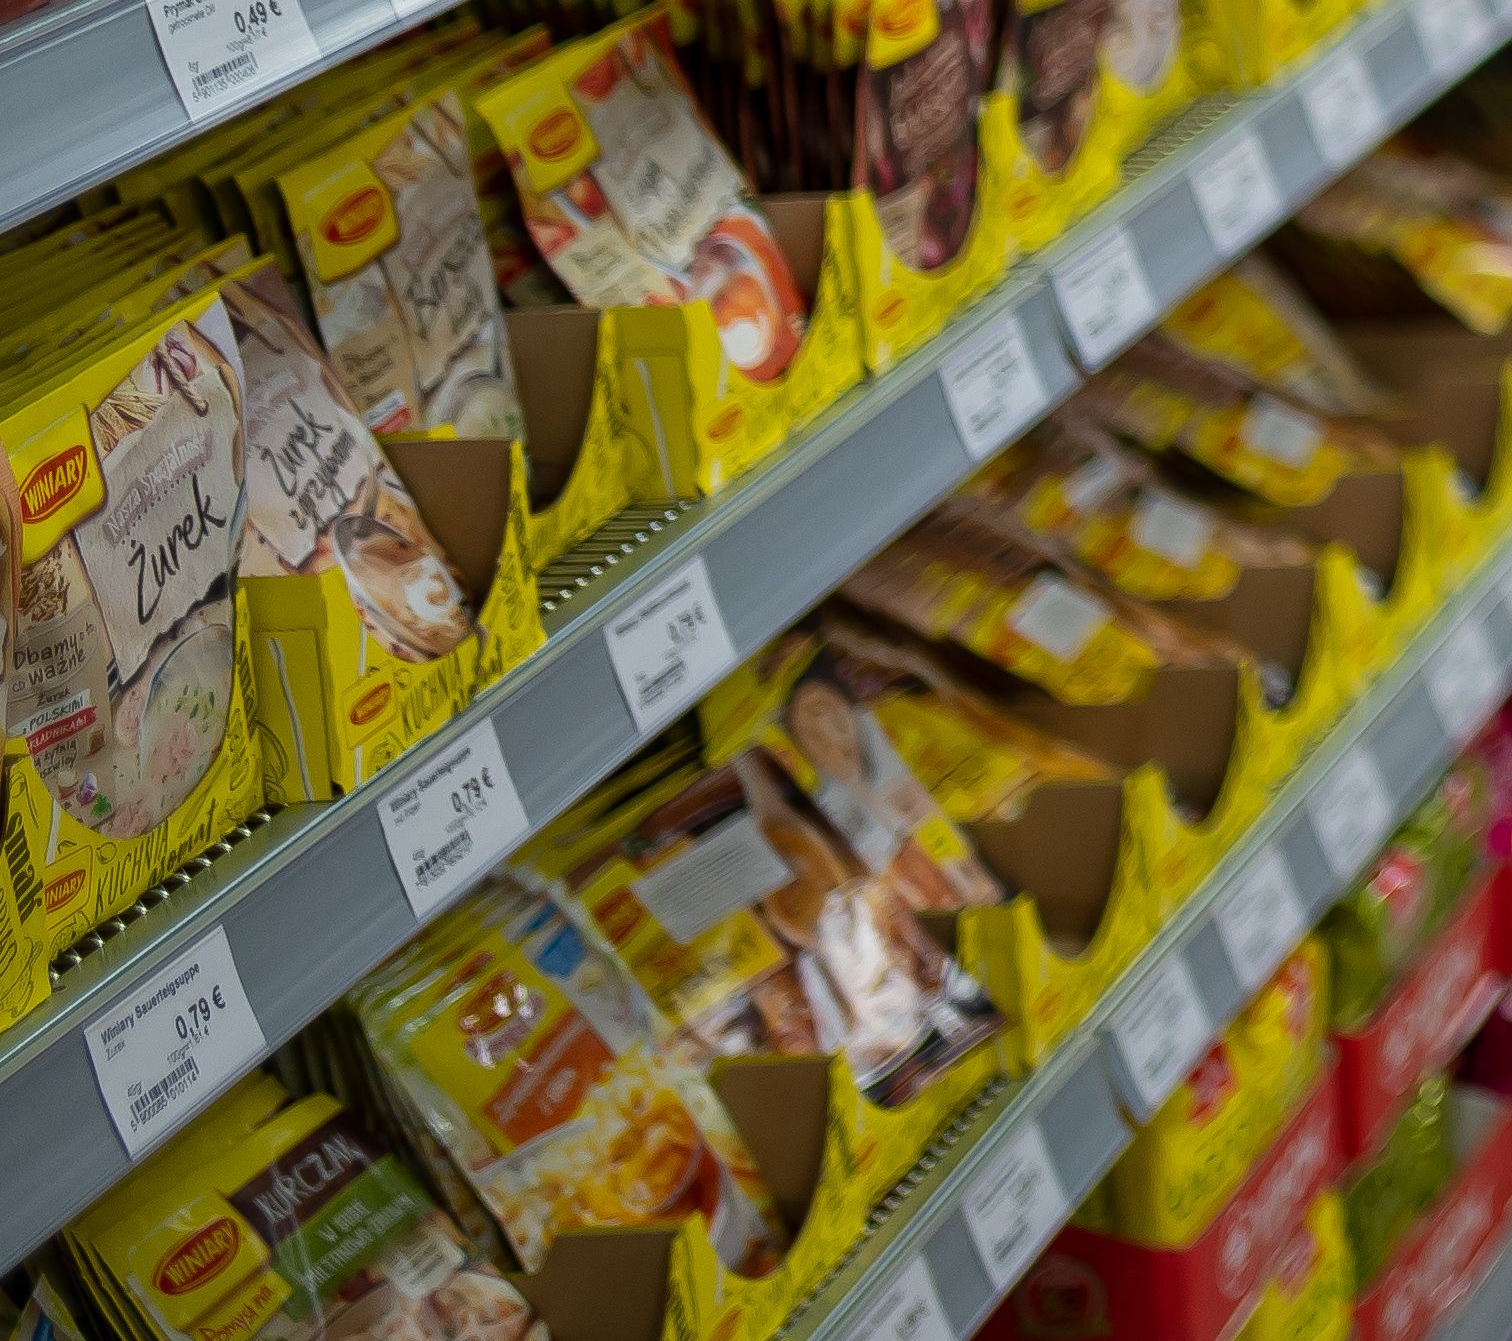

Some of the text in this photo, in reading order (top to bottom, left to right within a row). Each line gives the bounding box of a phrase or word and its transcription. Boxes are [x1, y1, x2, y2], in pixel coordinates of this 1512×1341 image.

[234, 0, 268, 34] 0,49
[23, 450, 85, 516] WINIARY
[128, 473, 227, 625] Żurek
[13, 633, 79, 670] Dbamy
[29, 694, 84, 732] POLSKIMI
[30, 715, 88, 752] KŁADNIKAMI
[480, 766, 494, 789] €
[46, 871, 85, 903] INIARY
[94, 819, 169, 919] KUCHNIA
[100, 963, 200, 1046] Winiary Sauerteigsuppe
[175, 984, 226, 1041] 0,79 €
[163, 1220, 235, 1287] WINIARY
